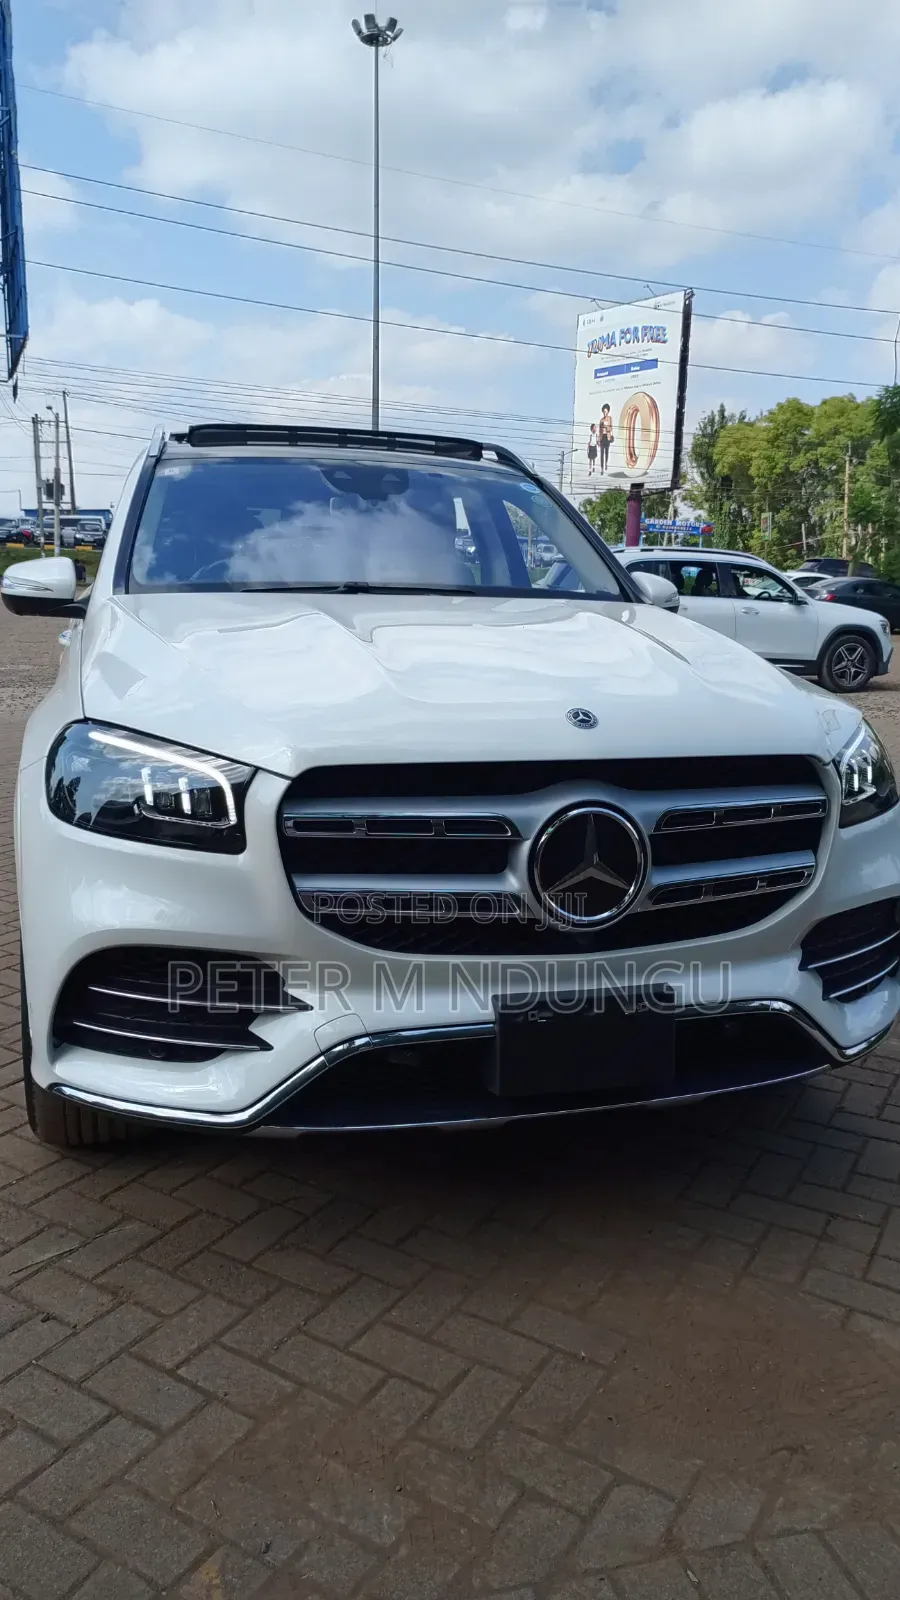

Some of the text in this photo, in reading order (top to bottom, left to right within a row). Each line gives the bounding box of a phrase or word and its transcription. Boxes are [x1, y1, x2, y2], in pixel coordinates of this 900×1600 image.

[619, 326, 640, 346] FOR
[641, 325, 668, 344] FREE
[645, 518, 673, 526] GARDEN
[675, 520, 704, 528] MOTORS
